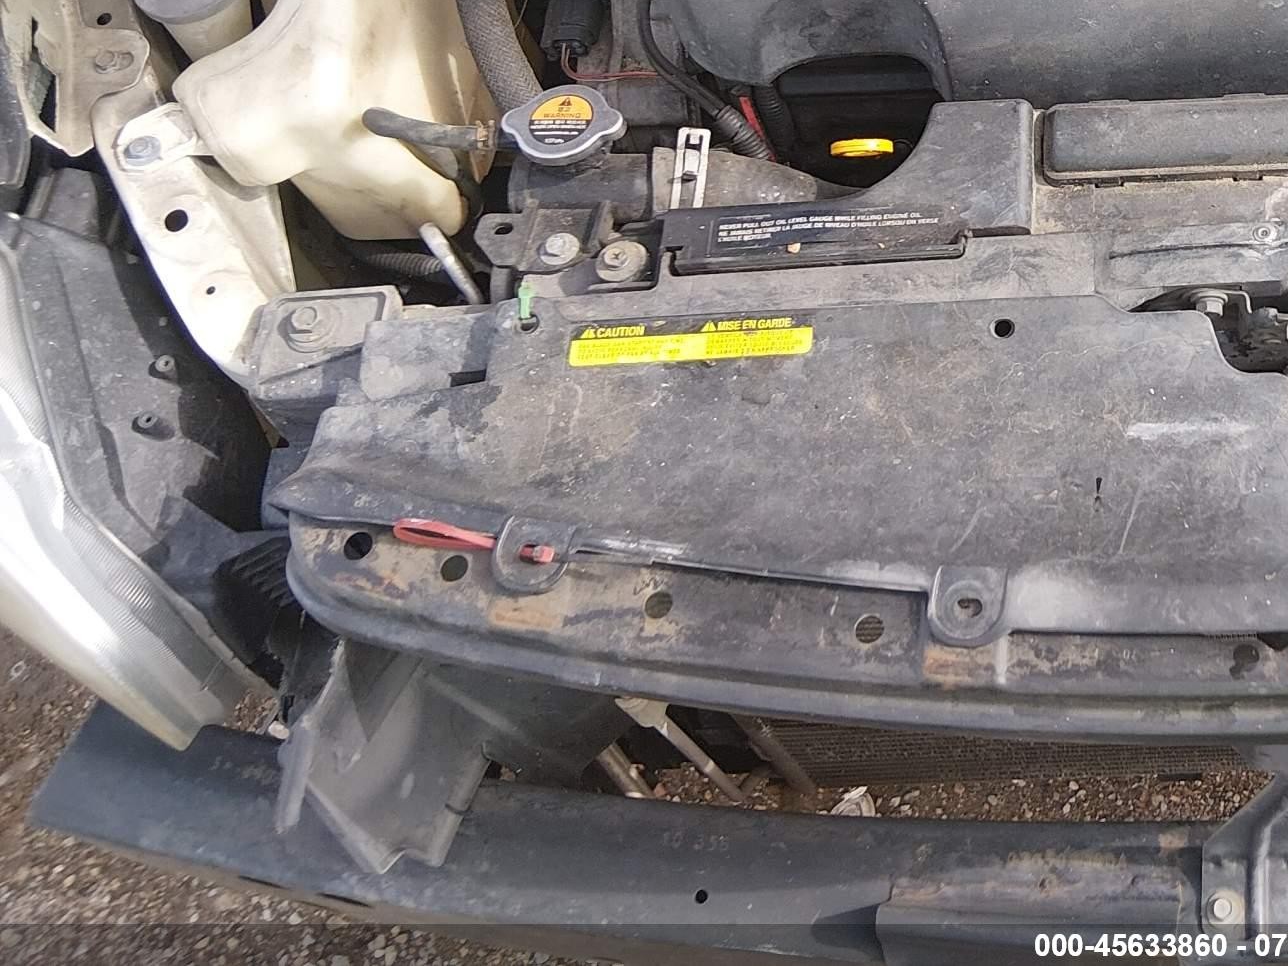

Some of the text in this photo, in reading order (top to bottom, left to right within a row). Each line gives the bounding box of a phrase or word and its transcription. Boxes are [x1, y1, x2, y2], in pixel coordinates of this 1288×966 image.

[717, 317, 793, 331] MISE EN GARDE
[596, 325, 645, 338] CAUTION
